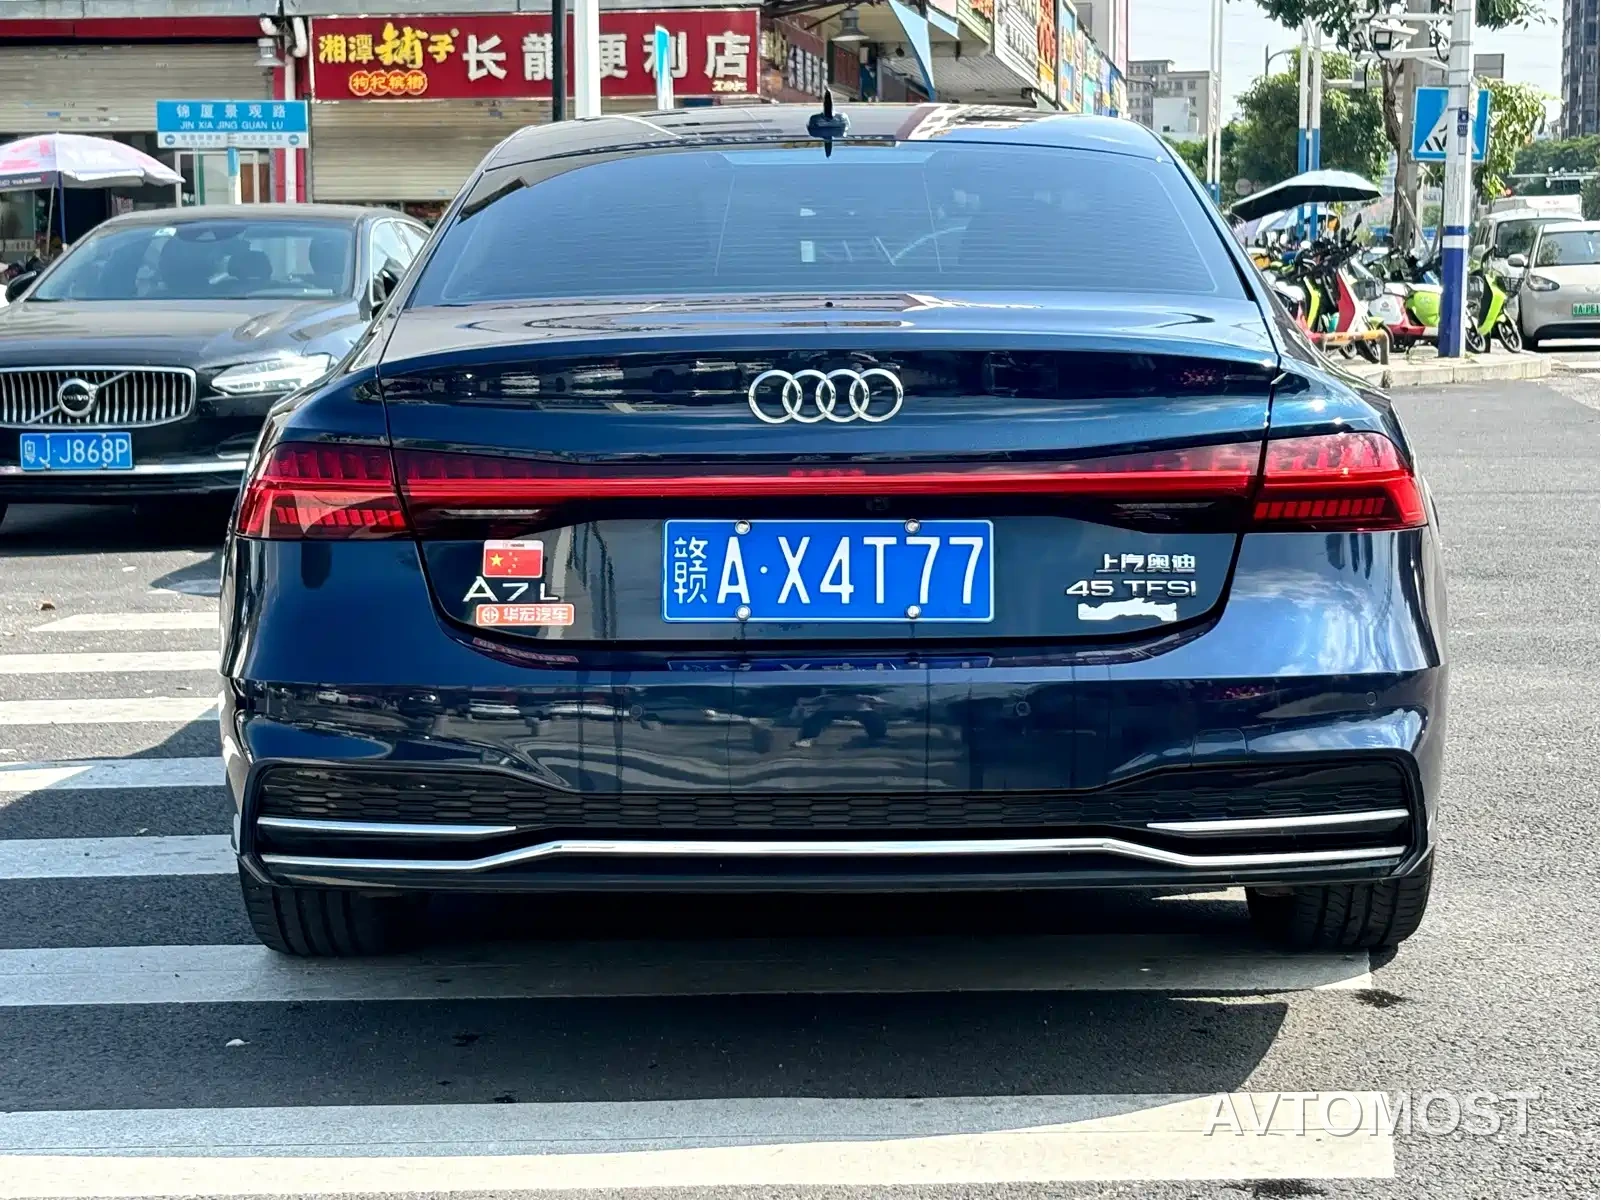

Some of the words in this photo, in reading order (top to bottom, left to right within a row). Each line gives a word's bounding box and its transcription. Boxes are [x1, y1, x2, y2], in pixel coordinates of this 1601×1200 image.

[318, 22, 456, 69] 湘潭铺子
[176, 104, 286, 119] 锦厦景观路
[180, 121, 195, 130] JIN
[198, 121, 213, 130] XIA
[217, 121, 238, 130] JING
[241, 121, 268, 130] GUAN
[272, 121, 284, 130] LU
[1096, 553, 1196, 573] 上汽奥迪
[1066, 580, 1115, 597] 45
[1123, 580, 1197, 597] TFSI
[503, 606, 569, 622] 华宏汽车
